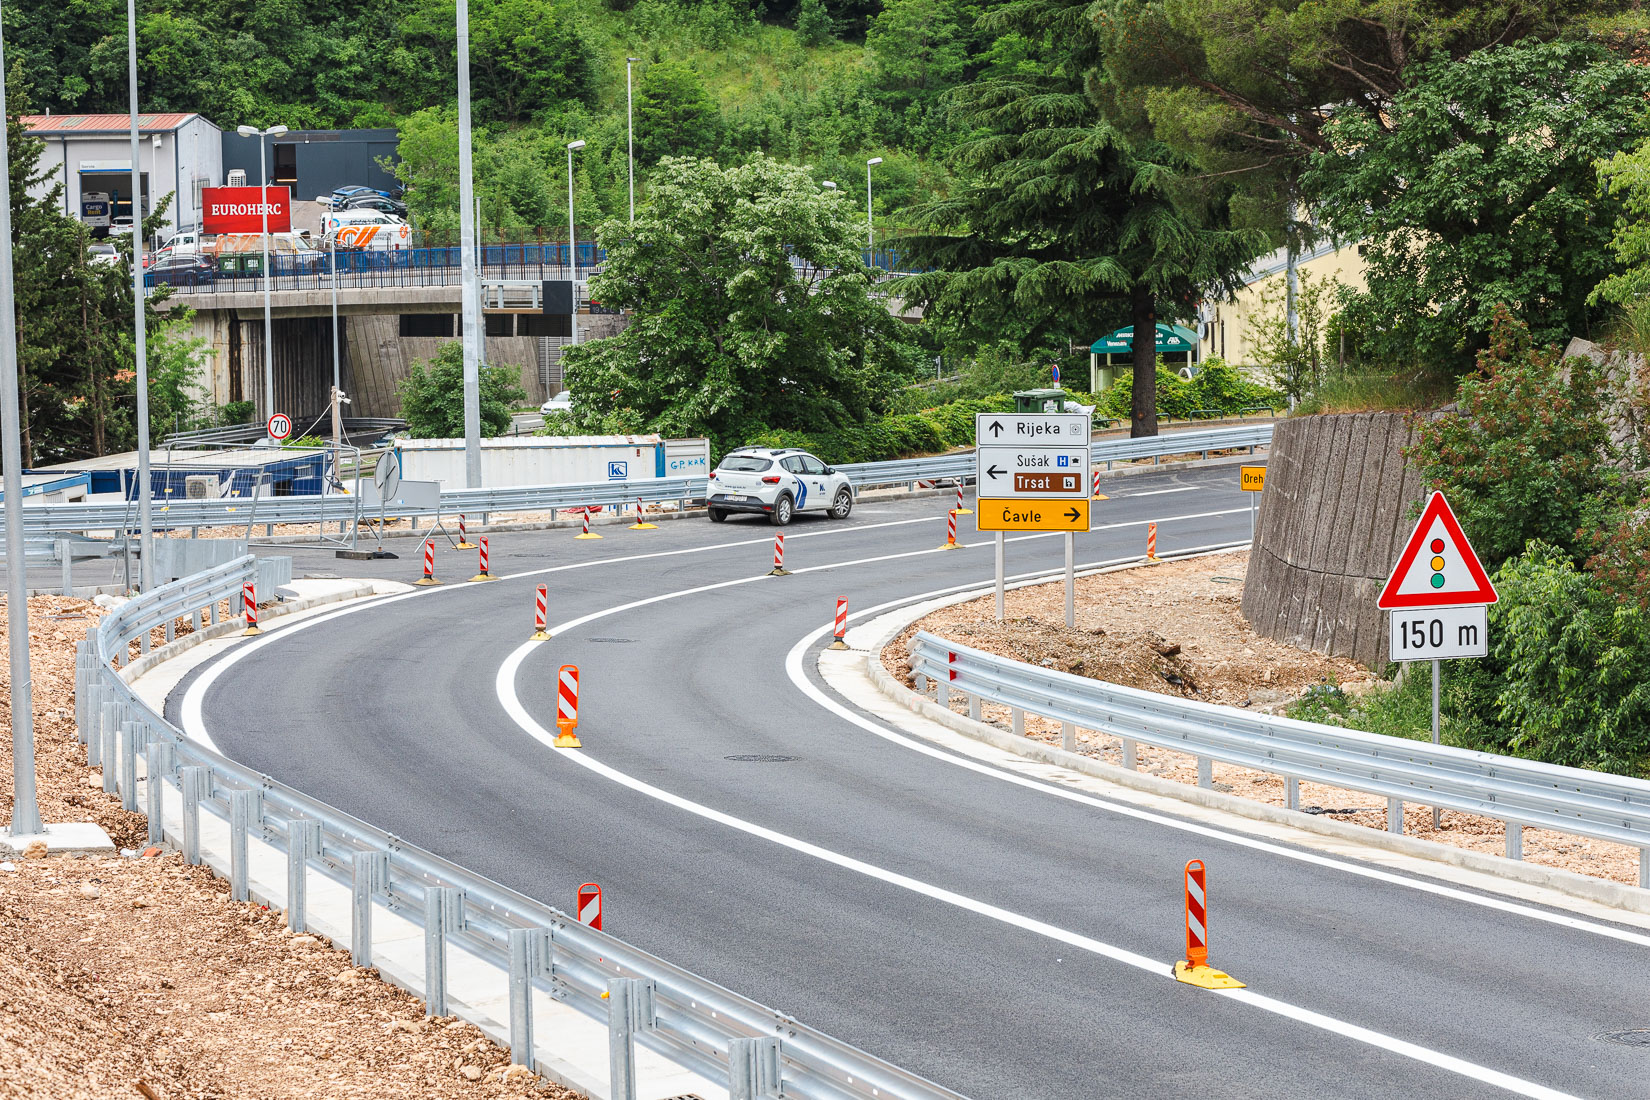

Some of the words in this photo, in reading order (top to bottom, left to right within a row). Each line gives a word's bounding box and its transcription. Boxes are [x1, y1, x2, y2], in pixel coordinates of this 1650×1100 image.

[211, 203, 282, 216] EUROHERC
[273, 420, 287, 433] 70
[1016, 421, 1061, 437] Rijeka
[1016, 454, 1050, 467] Sušak
[1017, 475, 1051, 489] Trsat
[1243, 473, 1265, 484] Oreh
[1002, 506, 1042, 523] Čavle
[1400, 618, 1444, 650] 150
[1458, 624, 1478, 646] m
